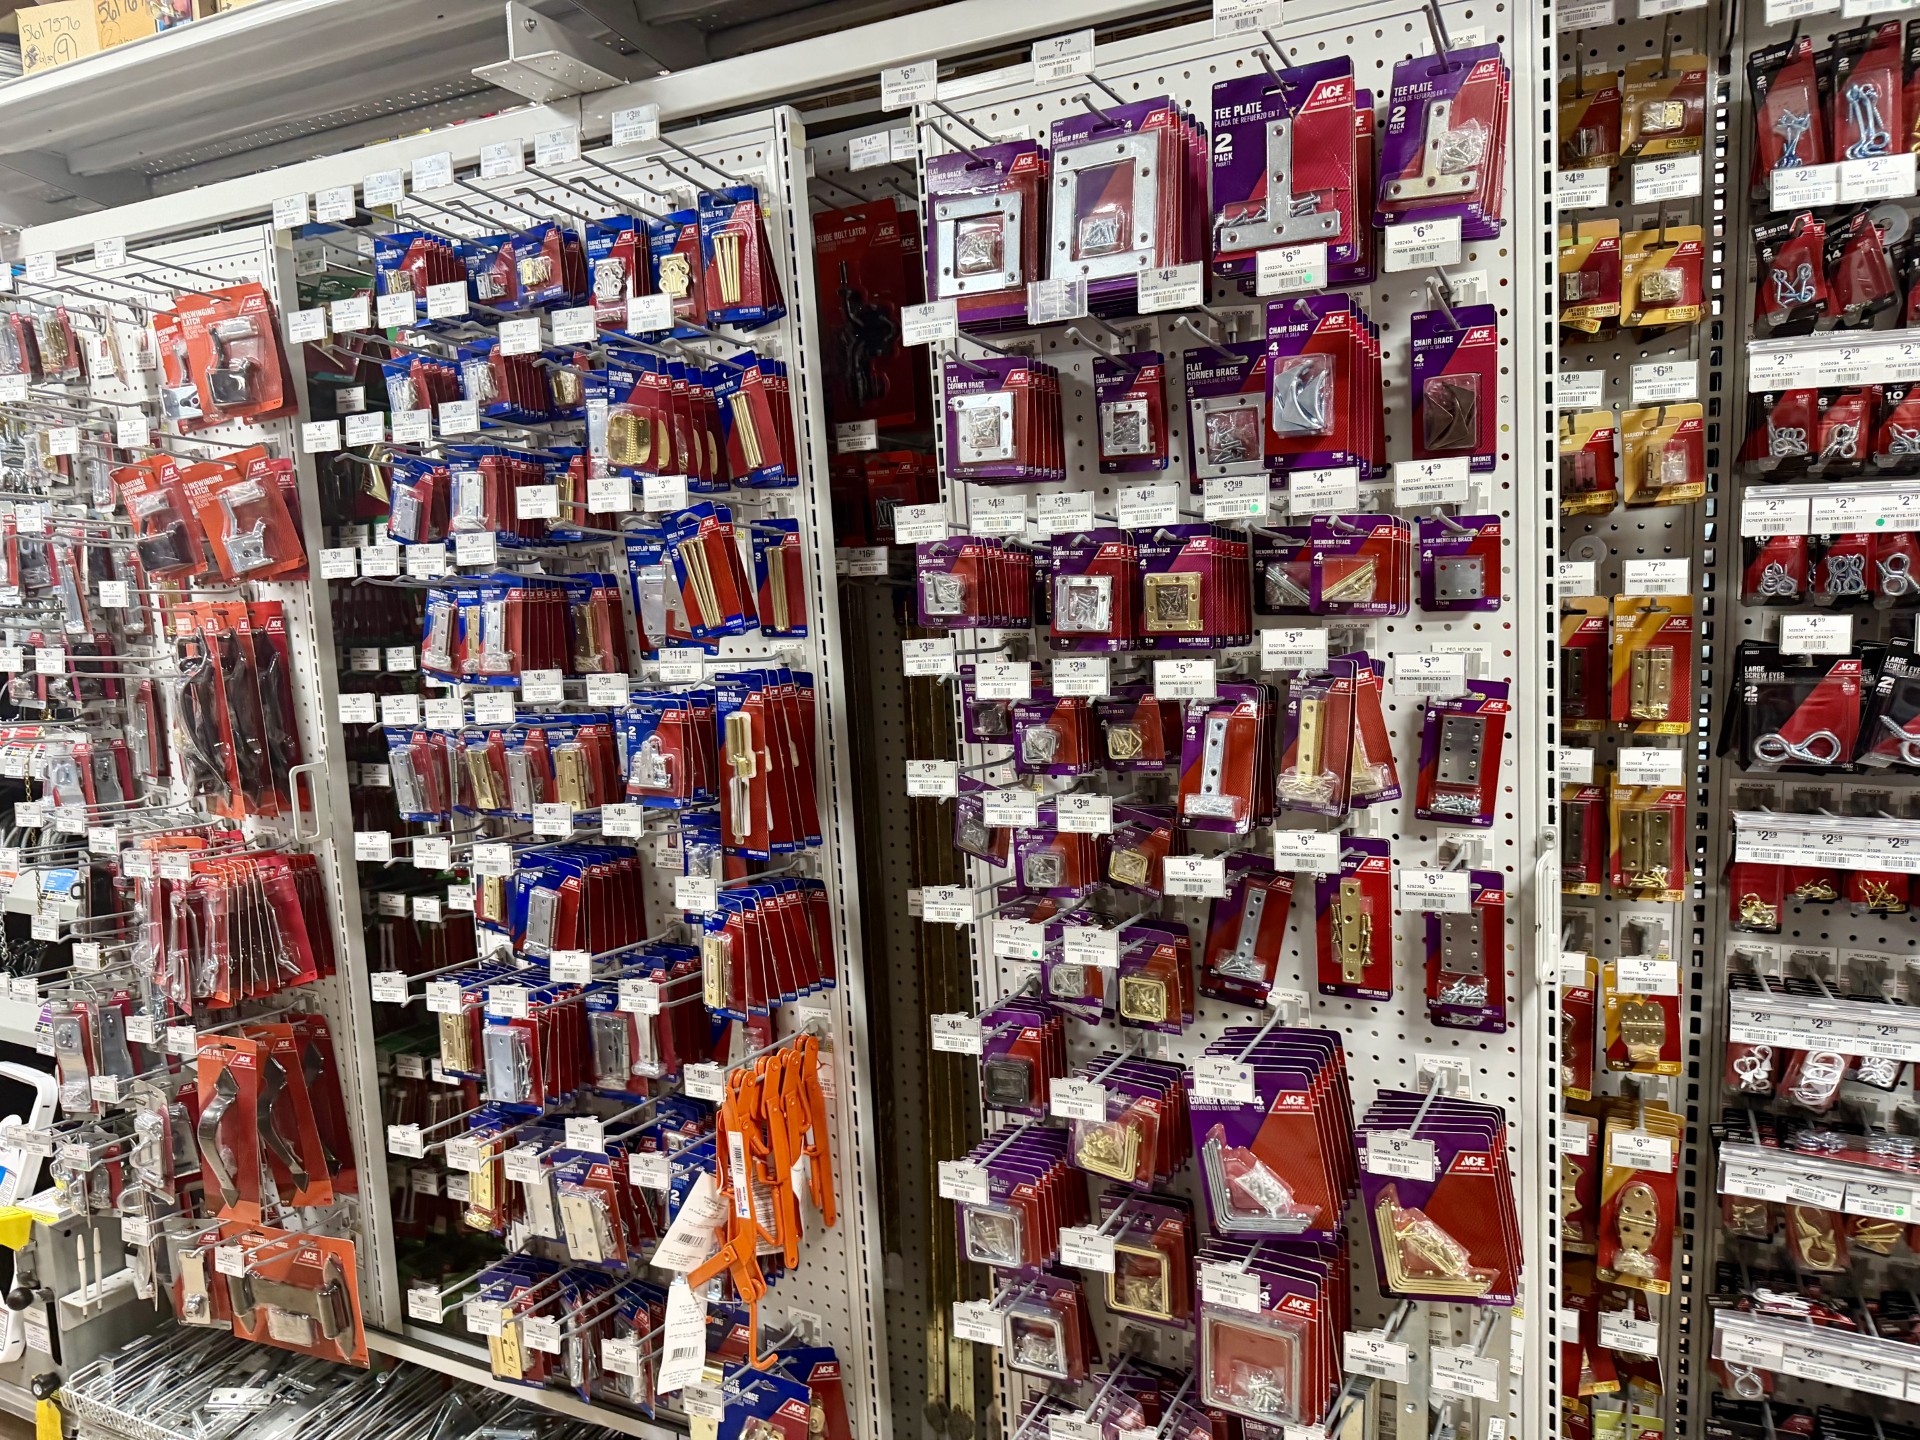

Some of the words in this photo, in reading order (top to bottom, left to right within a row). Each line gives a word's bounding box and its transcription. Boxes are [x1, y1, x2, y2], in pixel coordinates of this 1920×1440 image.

[22, 16, 80, 41] 5617576
[1054, 38, 1071, 51] $759
[1839, 58, 1850, 67] 2
[1476, 63, 1495, 74] ACE
[1757, 76, 1767, 85] 2
[1394, 85, 1408, 96] TEE
[1409, 82, 1433, 93] PLATE
[1214, 108, 1232, 120] TEE
[1234, 101, 1262, 116] PLATE
[1391, 106, 1407, 123] 2
[1214, 118, 1230, 128] PLACA
[1231, 117, 1238, 125] DE
[1239, 112, 1267, 124] REFUERZO
[1215, 133, 1233, 153] 2
[1214, 152, 1233, 162] PACK
[1655, 162, 1675, 174] $599
[1867, 158, 1888, 171] $279
[1565, 172, 1585, 183] $499
[1795, 170, 1816, 181] $259
[817, 233, 832, 243] SLIDE
[834, 230, 848, 240] BOLT
[849, 227, 867, 237] LATCH
[1413, 224, 1433, 237] $659
[1282, 249, 1301, 262] $659
[1762, 248, 1773, 257] 2
[1825, 250, 1842, 262] 14
[1158, 270, 1177, 281] $499
[181, 307, 215, 318] INSWINGING
[182, 317, 200, 327] LATCH
[1326, 315, 1345, 325] ACE
[1269, 326, 1287, 335] CHAIR
[1289, 324, 1308, 332] BRACE
[1471, 330, 1490, 339] ACE
[1269, 342, 1279, 351] 4
[1414, 354, 1424, 362] 4
[1840, 348, 1860, 359] $299
[1774, 354, 1793, 365] $279
[1186, 362, 1202, 372] FLAT
[1653, 365, 1673, 377] $659
[1187, 368, 1214, 380] CORNER
[1216, 366, 1239, 376] BRACE
[1561, 373, 1580, 384] $499
[643, 375, 656, 383] ACE
[1764, 394, 1773, 403] 8
[1886, 391, 1903, 400] 10
[718, 398, 724, 406] 3
[1818, 397, 1828, 406] 6
[253, 462, 266, 470] ACE
[1421, 464, 1441, 476] $459
[188, 475, 223, 488] INSWINGING
[1313, 472, 1332, 483] $499
[120, 477, 146, 490] ADJUSTABLE
[1223, 480, 1243, 492] $399
[190, 485, 210, 496] LATCH
[1137, 490, 1154, 501] $499
[1766, 500, 1785, 510] $279
[1836, 497, 1855, 508] $279
[671, 549, 678, 557] 3
[1423, 550, 1433, 558] 4
[1648, 562, 1666, 572] $759
[1807, 618, 1825, 628] $459
[1285, 632, 1302, 642] $599
[1420, 657, 1440, 668] $599
[1886, 656, 1908, 665] LARGE
[1176, 663, 1192, 673] $599
[1884, 662, 1909, 672] SCREW
[1744, 686, 1758, 697] 2
[1288, 701, 1297, 709] 4
[629, 726, 636, 735] 2
[1297, 835, 1315, 846] $699
[1757, 831, 1778, 841] $259
[1822, 834, 1843, 844] $259
[1888, 838, 1909, 848] $259
[1424, 874, 1443, 885] $659
[1639, 961, 1656, 972] $599
[1751, 1012, 1770, 1022] $259
[1812, 1018, 1832, 1029] $259
[1877, 1025, 1898, 1035] $259
[1189, 1097, 1218, 1105] CORNER
[1282, 1094, 1306, 1105] ACE
[1390, 1140, 1408, 1151] $859
[670, 1162, 684, 1171] LIGHT
[1461, 1156, 1486, 1166] ACE
[670, 1190, 680, 1200] 2
[302, 1252, 317, 1260] ACE
[1288, 1298, 1312, 1311] ACE
[1454, 1357, 1473, 1369] $799
[1436, 1372, 1456, 1380] MENDING
[788, 1403, 805, 1414] ACE
